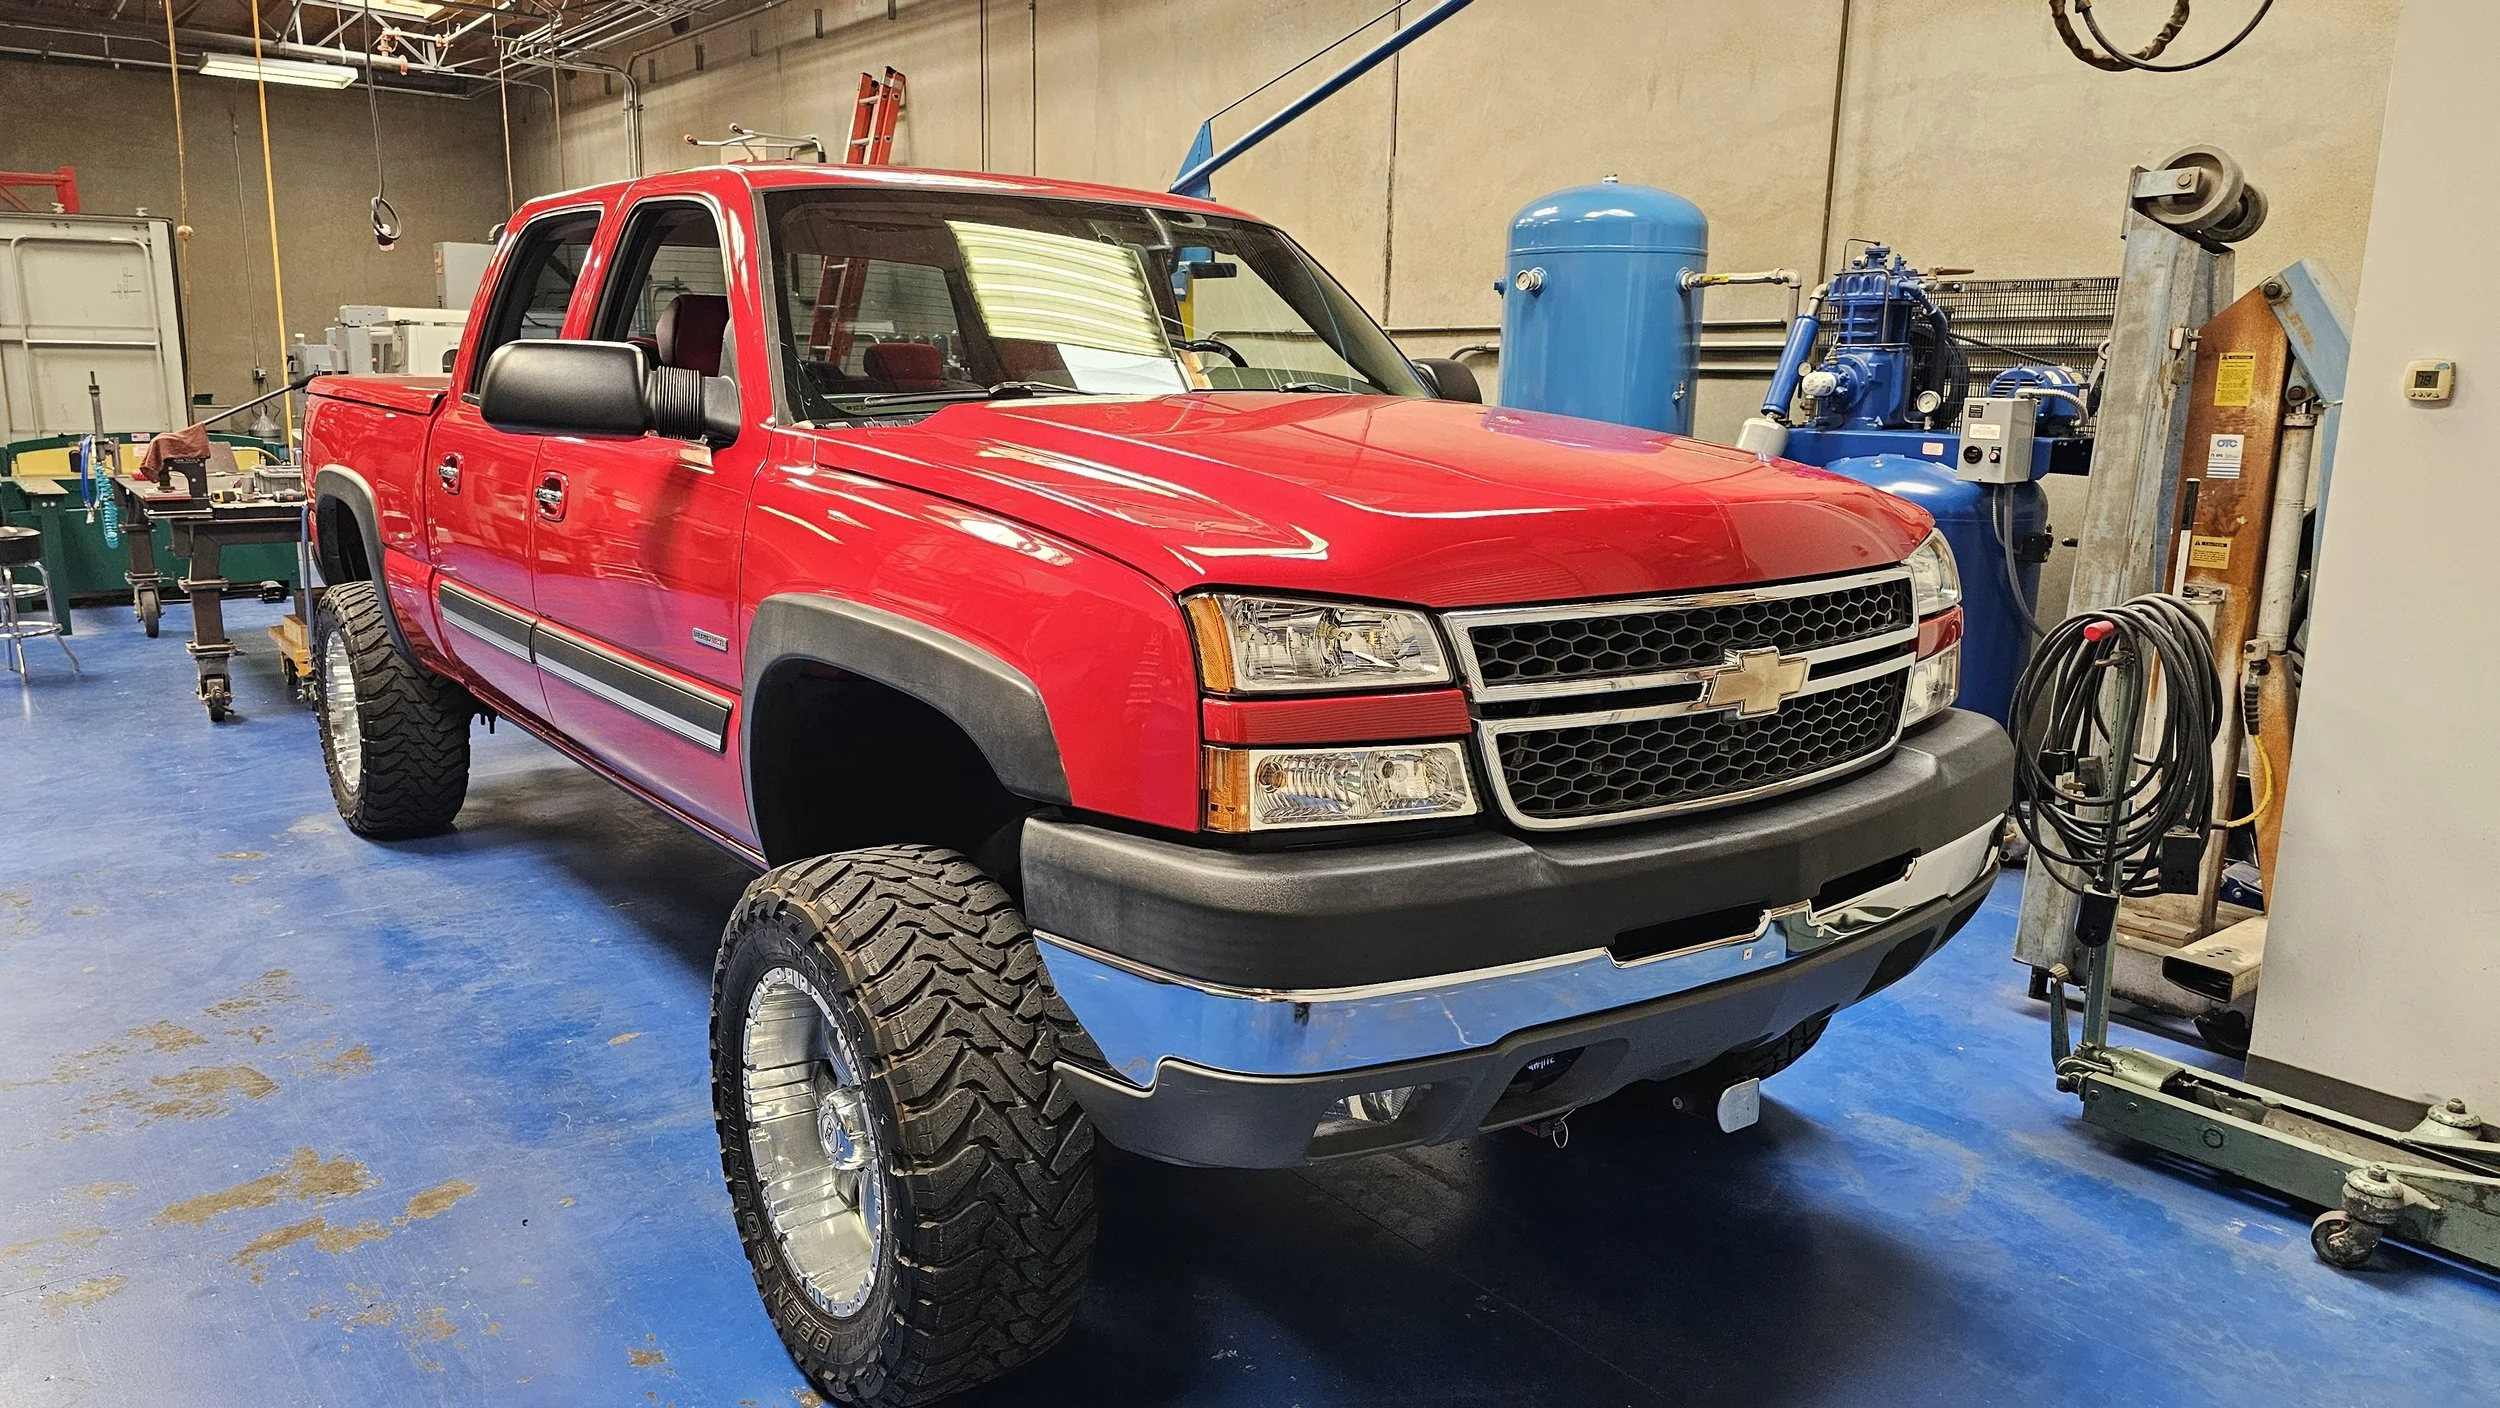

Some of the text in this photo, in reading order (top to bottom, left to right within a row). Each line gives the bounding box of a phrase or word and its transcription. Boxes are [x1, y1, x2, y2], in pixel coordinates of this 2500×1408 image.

[2419, 374, 2432, 386] 78
[2216, 439, 2238, 448] OTC
[772, 1281, 834, 1354] OPEN
